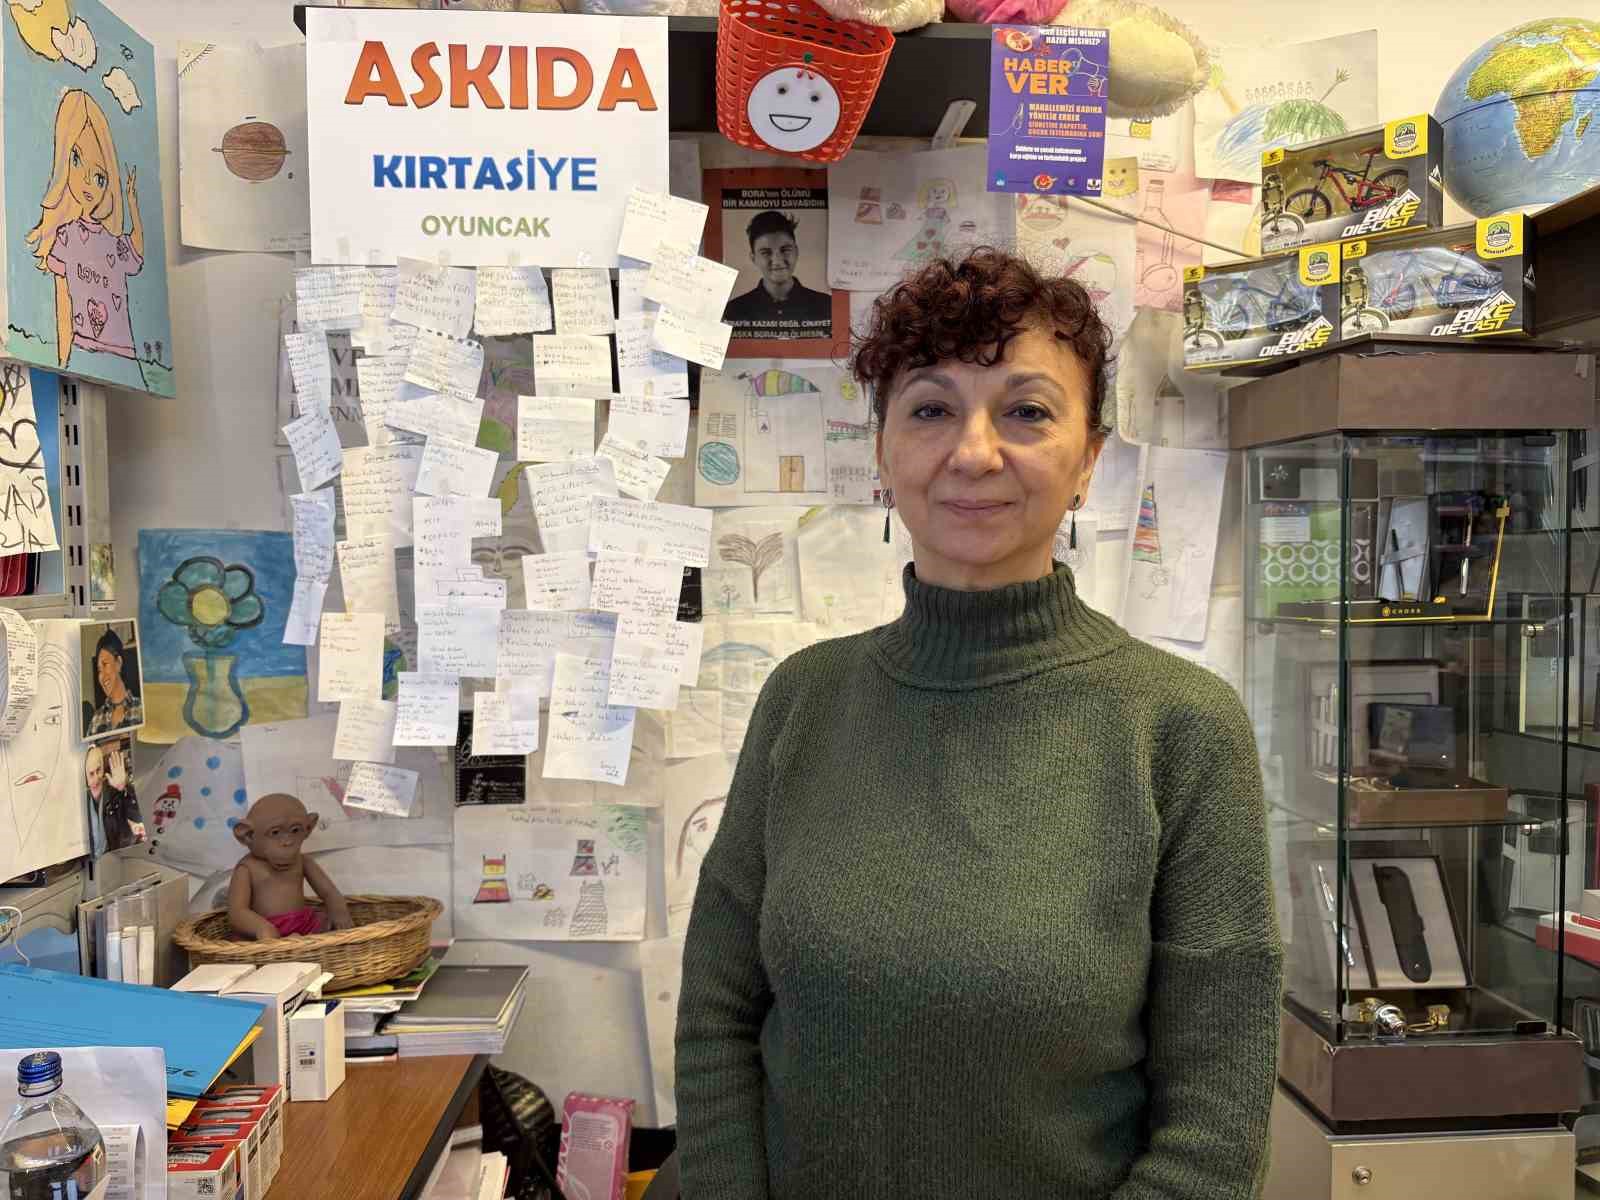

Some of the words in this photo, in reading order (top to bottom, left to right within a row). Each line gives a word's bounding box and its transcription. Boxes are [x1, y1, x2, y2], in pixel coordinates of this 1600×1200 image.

[344, 40, 658, 111] ASKIDA
[1004, 57, 1072, 74] HABER
[1004, 72, 1069, 96] VER
[373, 149, 598, 192] KIRTASİYE
[738, 199, 780, 208] KAMUOYU
[1363, 197, 1420, 223] BIKE
[421, 215, 551, 238] OYUNCAK
[1341, 216, 1412, 238] DIE-CAST
[1453, 300, 1515, 323] BIKE
[1279, 324, 1333, 347] BIKE
[1430, 319, 1505, 337] DIE-CAST
